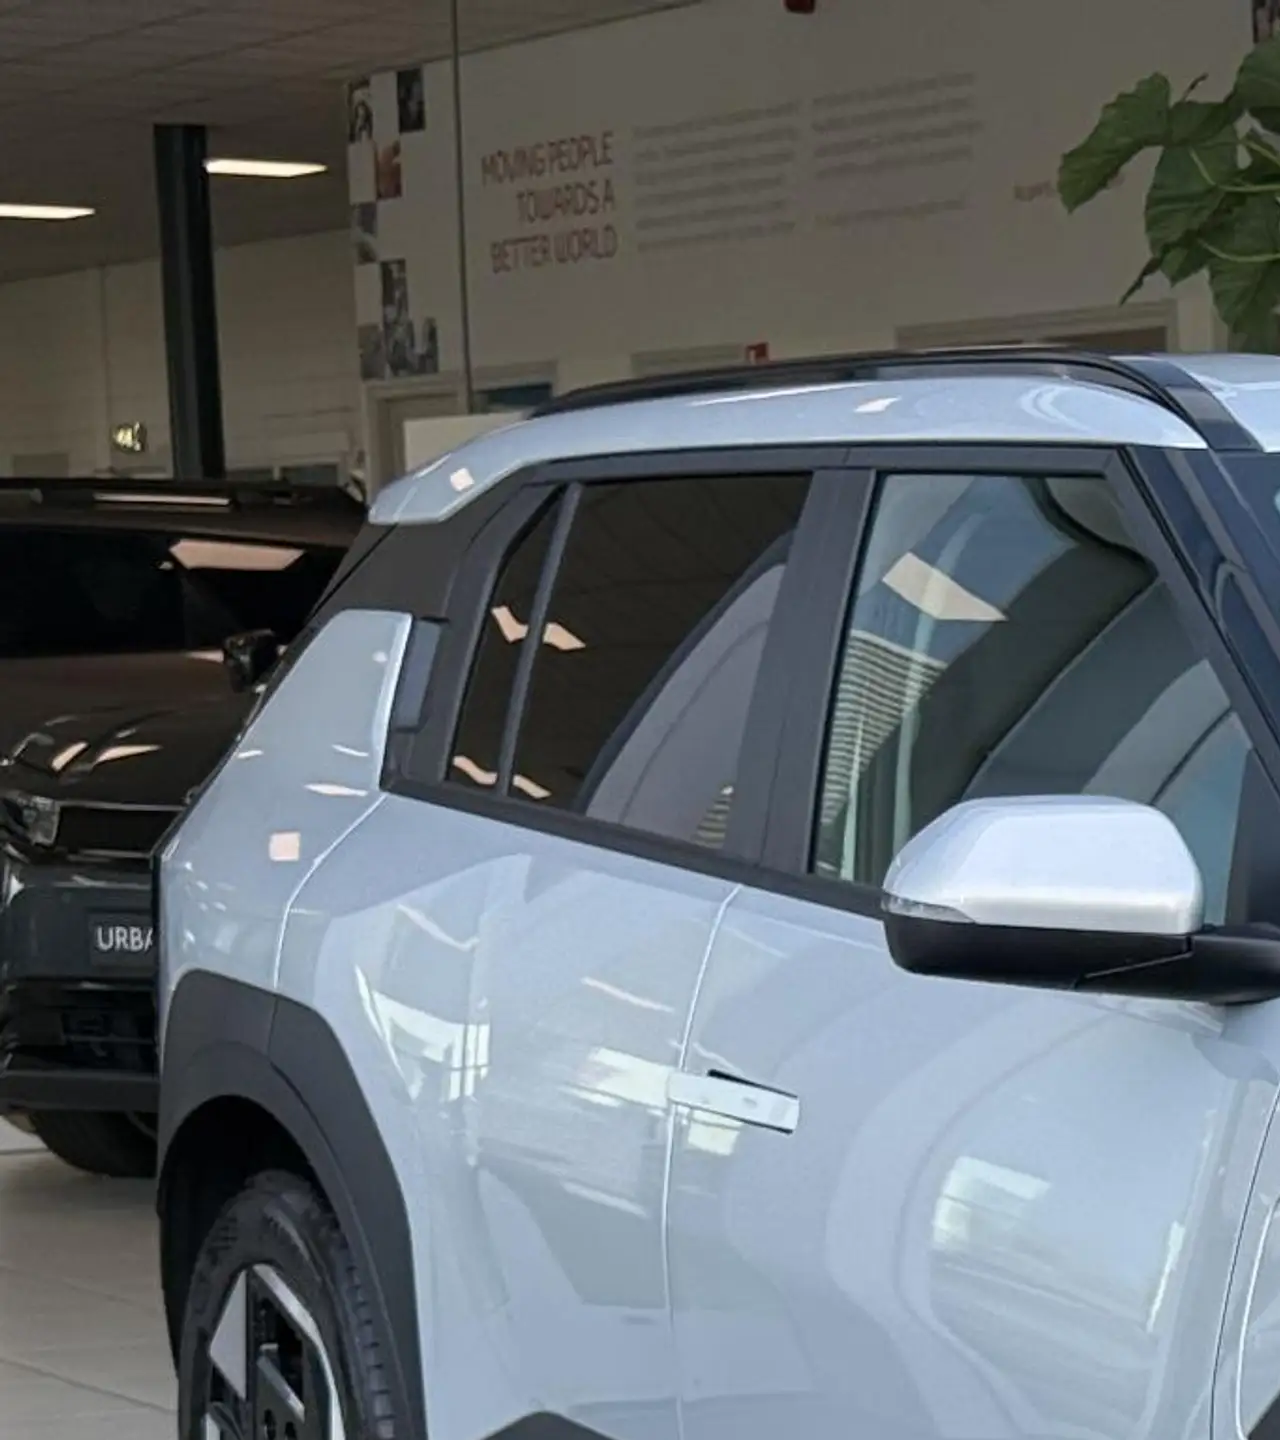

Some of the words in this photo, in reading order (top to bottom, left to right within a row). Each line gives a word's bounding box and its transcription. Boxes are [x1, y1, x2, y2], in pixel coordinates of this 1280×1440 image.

[481, 144, 545, 187] MOVING
[547, 130, 614, 175] PEOPLE
[516, 180, 600, 223] TOWARDS
[603, 177, 616, 212] A
[490, 234, 550, 274] BETTER
[553, 223, 618, 263] WORLD
